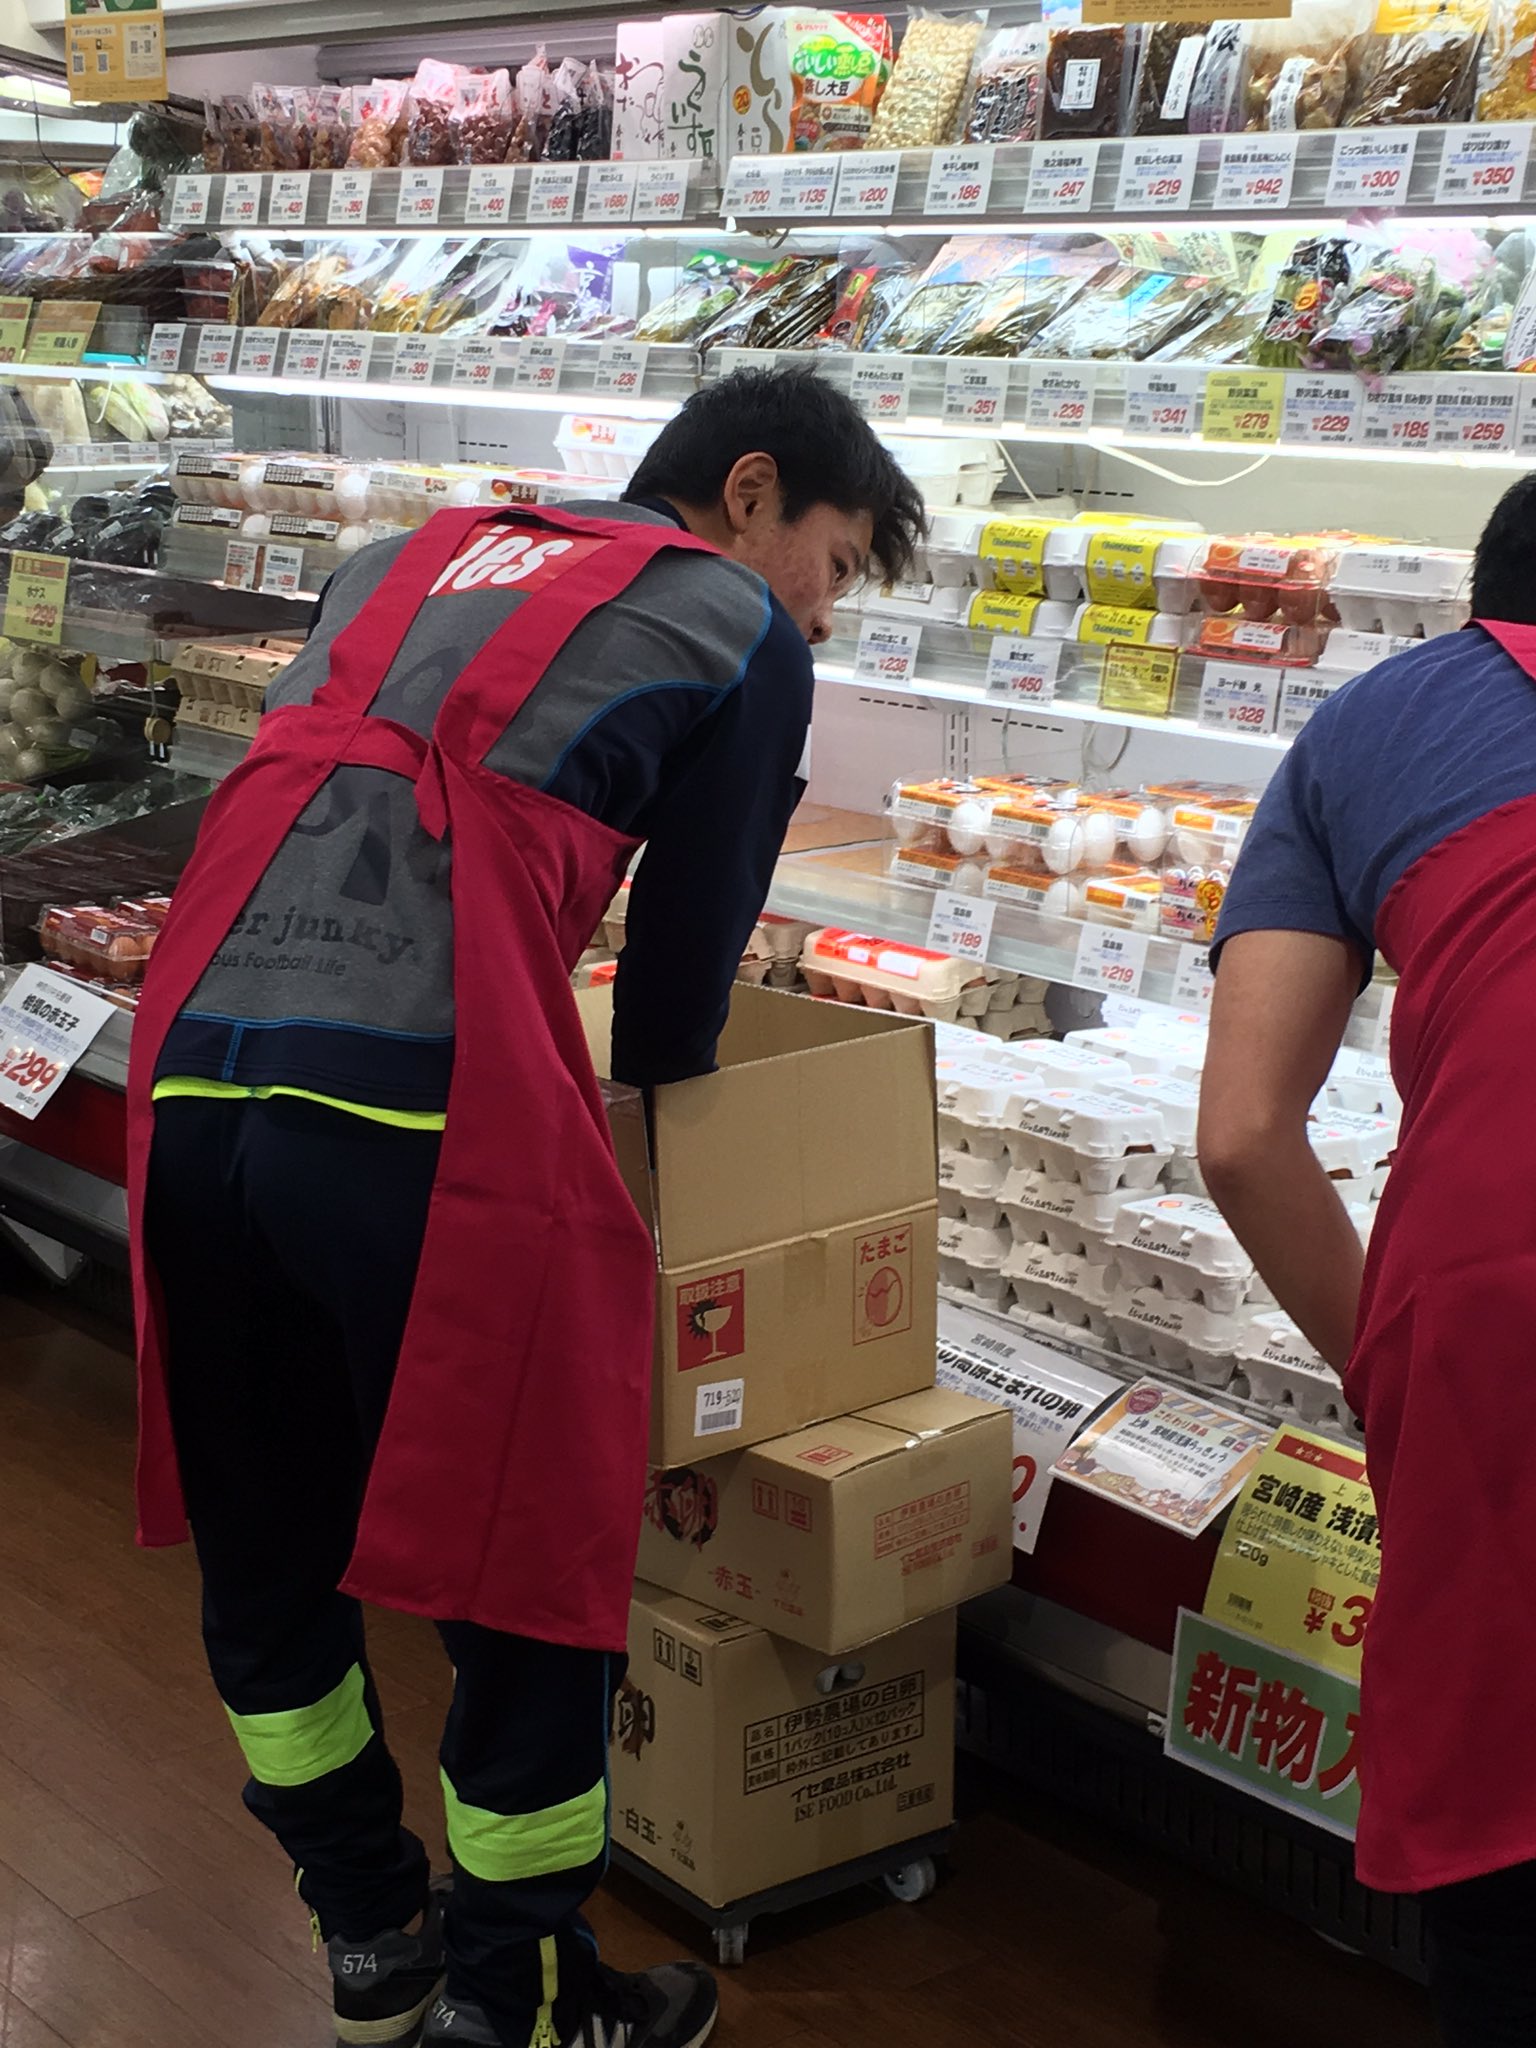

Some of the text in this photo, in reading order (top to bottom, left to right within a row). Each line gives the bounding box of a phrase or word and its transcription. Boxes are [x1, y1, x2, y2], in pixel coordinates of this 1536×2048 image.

[804, 78, 851, 97] 蒸し大豆
[861, 1233, 910, 1266] たまご
[679, 1274, 742, 1306] 取扱注意
[1250, 1473, 1381, 1549] 宮崎産 浅漬
[784, 1678, 918, 1734] 伊勢農場の白卵
[791, 1751, 912, 1803] イセ食品株式会社
[795, 1805, 815, 1823] ISE
[818, 1790, 854, 1815] FOOD
[341, 1952, 378, 1975] 574
